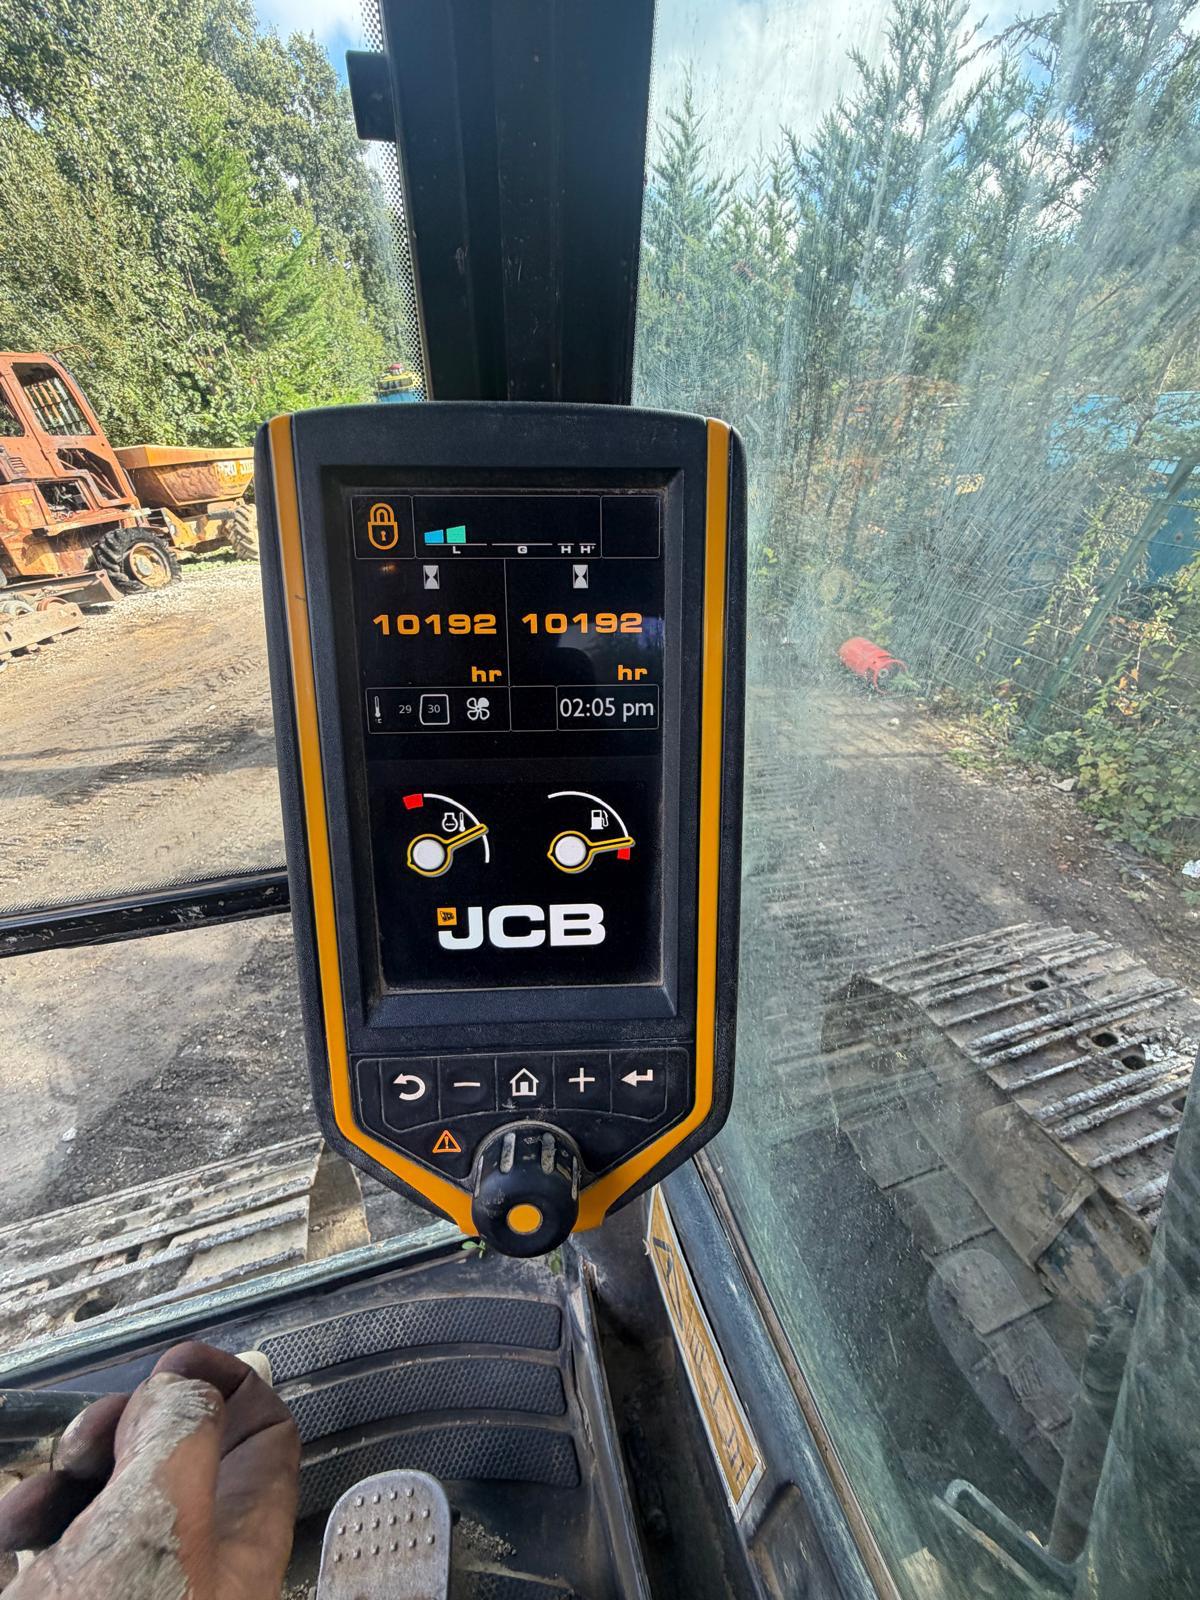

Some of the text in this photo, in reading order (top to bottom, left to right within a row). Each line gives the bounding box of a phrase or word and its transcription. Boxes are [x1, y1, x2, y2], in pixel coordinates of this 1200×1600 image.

[452, 545, 461, 554] L
[517, 545, 528, 554] G
[560, 545, 572, 554] H
[372, 613, 497, 635] 10192
[521, 612, 643, 634] 10192
[471, 666, 502, 682] hr
[617, 664, 648, 680] hr
[398, 704, 412, 714] 29
[427, 704, 441, 714] 30
[559, 697, 654, 722] 02:05 pm
[437, 903, 606, 950] JCB
